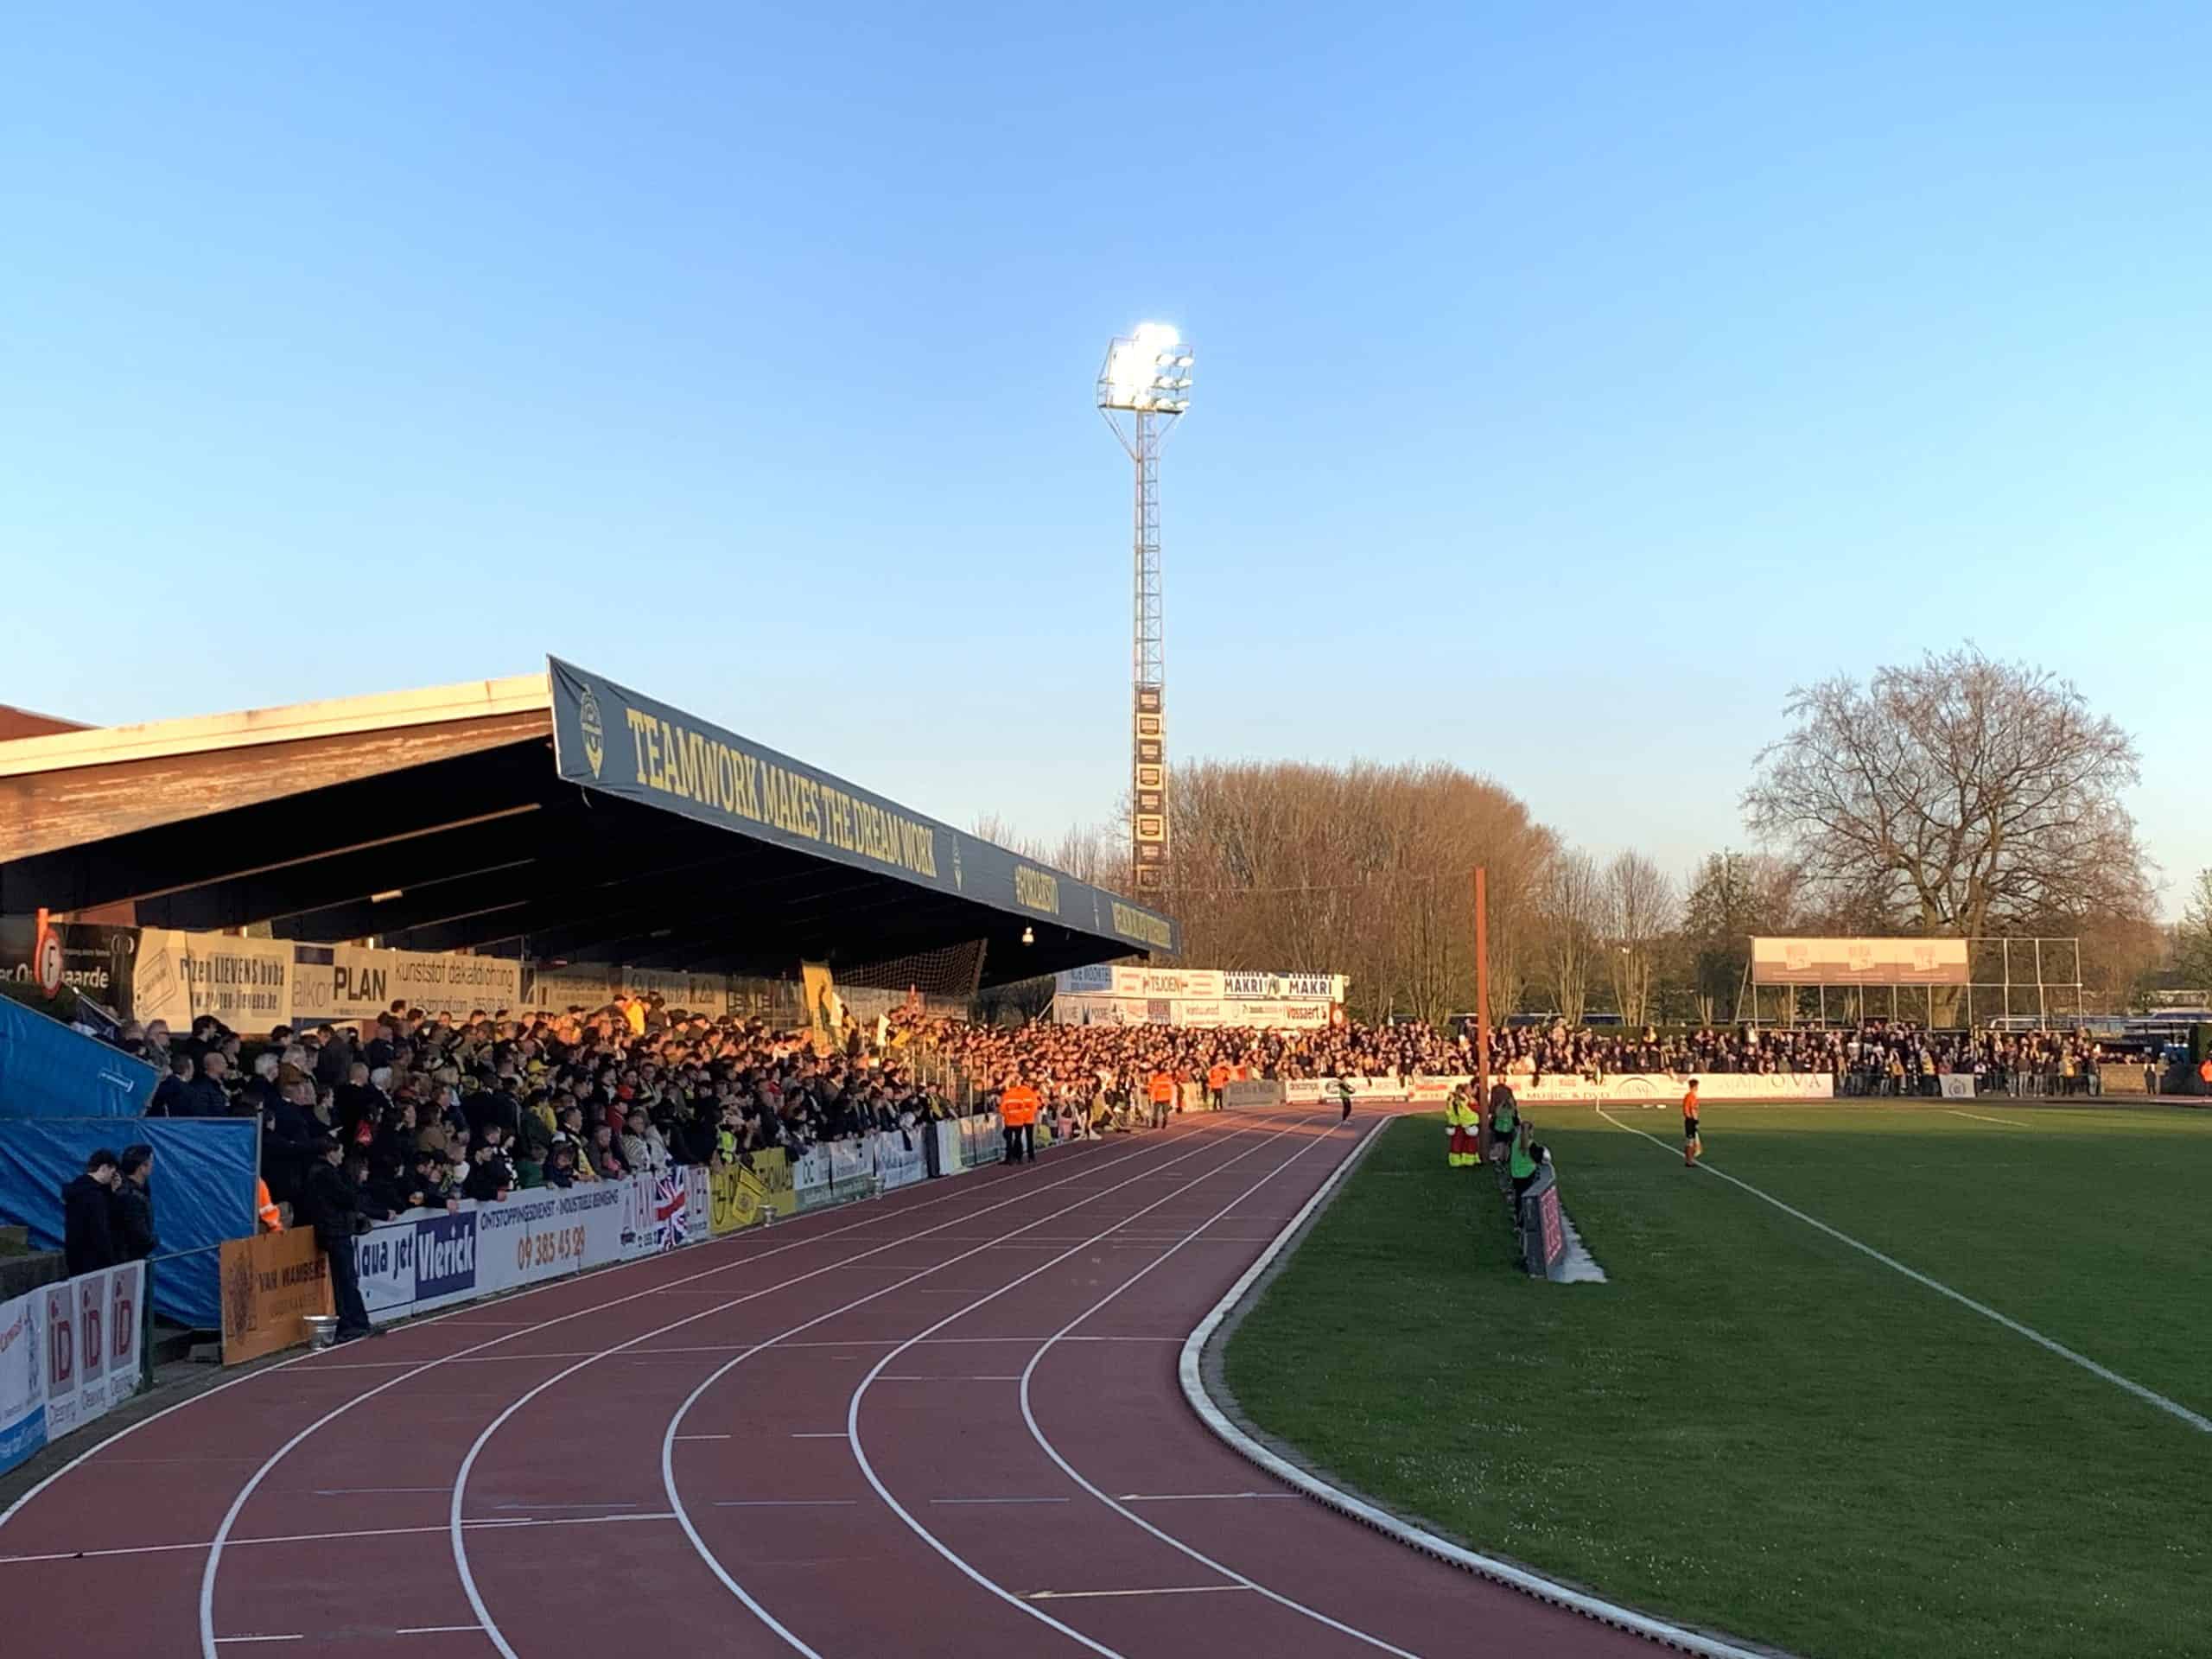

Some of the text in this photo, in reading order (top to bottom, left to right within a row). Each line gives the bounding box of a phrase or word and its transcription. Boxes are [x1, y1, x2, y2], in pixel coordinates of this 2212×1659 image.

[626, 707, 762, 823] TEAMWORK
[760, 760, 823, 841] MAKES
[820, 785, 855, 852] THE
[214, 956, 257, 984] LIEVENS
[1224, 978, 1262, 994] MAKRI
[1288, 980, 1332, 995] MAKRI
[418, 1223, 474, 1281] Vlerick
[535, 1230, 555, 1267] 385
